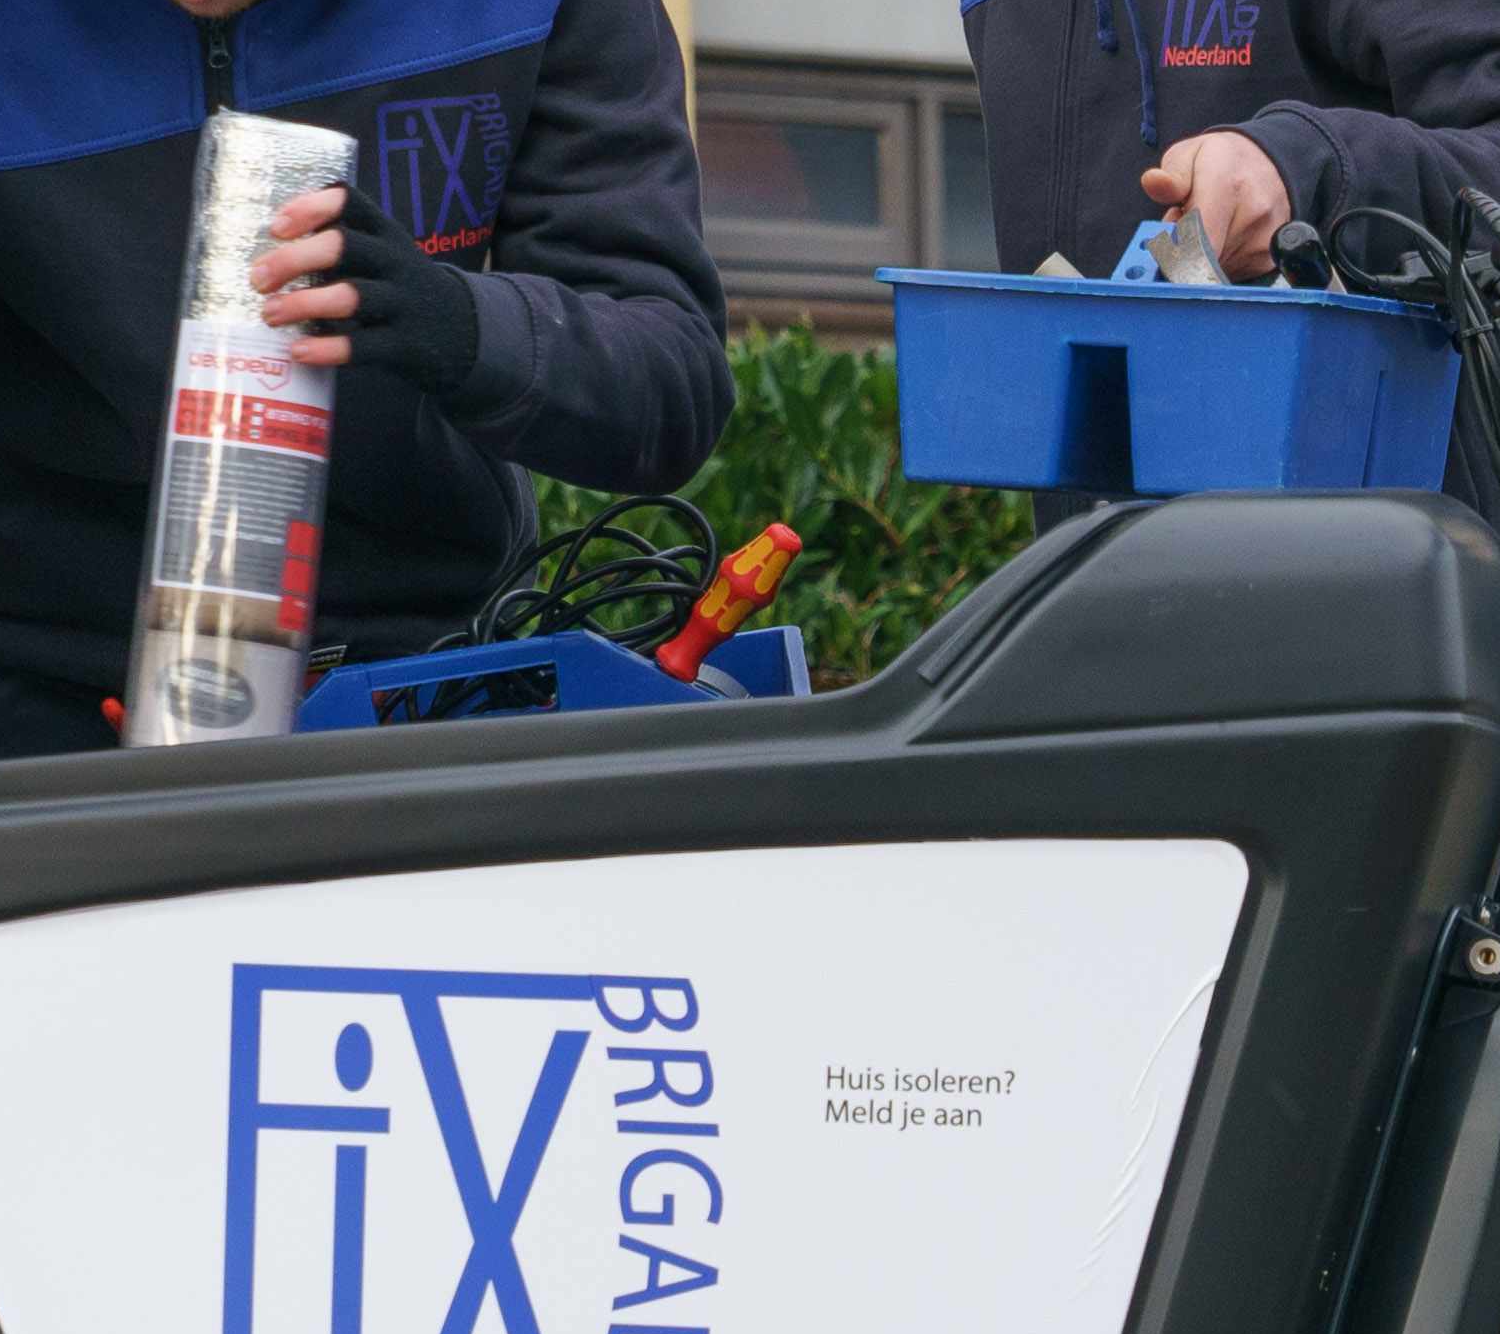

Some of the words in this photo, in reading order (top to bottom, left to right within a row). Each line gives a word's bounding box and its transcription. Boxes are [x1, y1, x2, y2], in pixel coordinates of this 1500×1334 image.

[1164, 43, 1252, 67] Nederland
[826, 1066, 885, 1091] Huis
[893, 1067, 1016, 1094] isoleren?
[824, 1099, 893, 1124] Meld
[900, 1101, 926, 1131] je
[933, 1107, 983, 1128] aan
